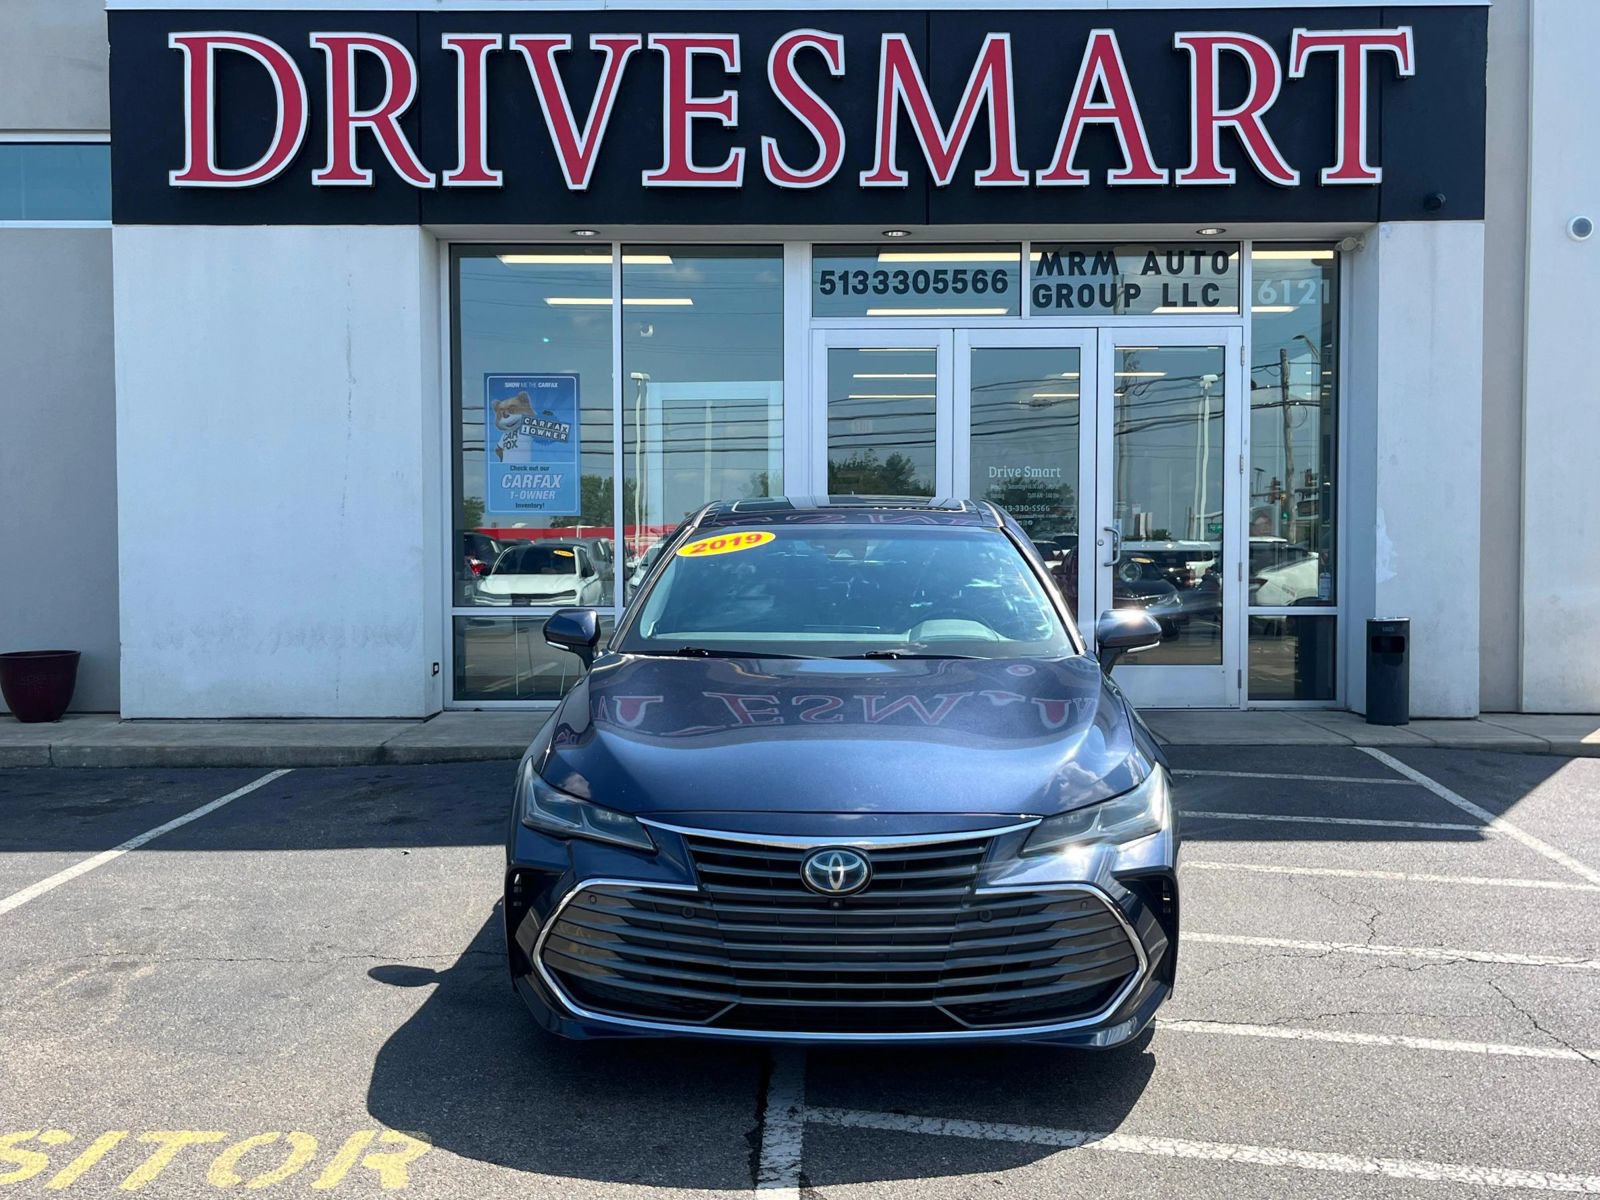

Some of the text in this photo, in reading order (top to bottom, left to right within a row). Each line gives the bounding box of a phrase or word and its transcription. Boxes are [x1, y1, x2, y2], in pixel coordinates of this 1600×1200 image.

[168, 26, 1416, 190] DRIVESMART
[1035, 249, 1230, 277] MRM AUTO
[819, 268, 1009, 297] 5133305566
[1257, 278, 1330, 305] 6121
[1031, 281, 1221, 309] GROUP LLC
[524, 417, 570, 433] CARFAX
[530, 428, 567, 441] OWNER
[501, 474, 563, 489] CARFAX
[988, 465, 1062, 478] Drive Smart
[510, 490, 556, 500] 1-OWNER
[689, 533, 763, 554] 2019
